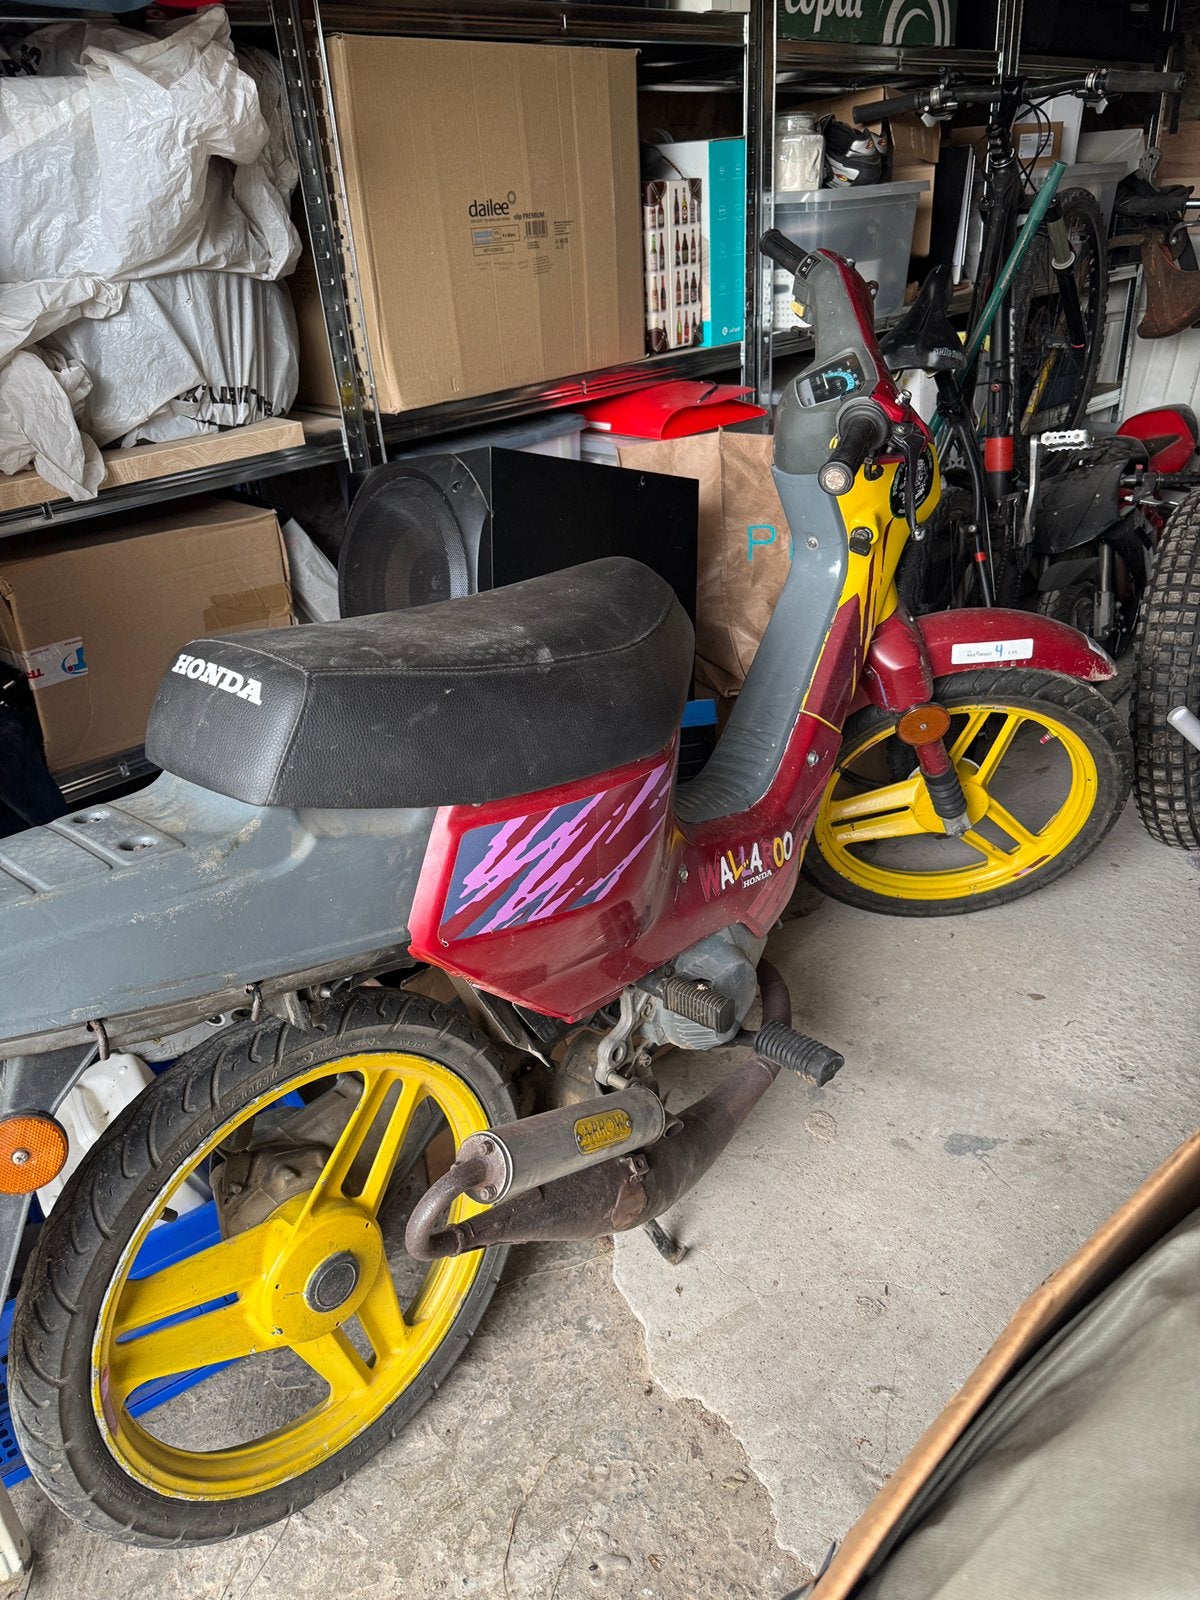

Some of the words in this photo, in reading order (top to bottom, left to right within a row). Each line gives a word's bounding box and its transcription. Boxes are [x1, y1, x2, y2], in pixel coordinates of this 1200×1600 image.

[468, 199, 510, 218] dailee
[994, 643, 1004, 657] 4
[171, 653, 263, 706] HONDA
[698, 830, 793, 899] WALLAROO
[742, 868, 773, 889] HONDA
